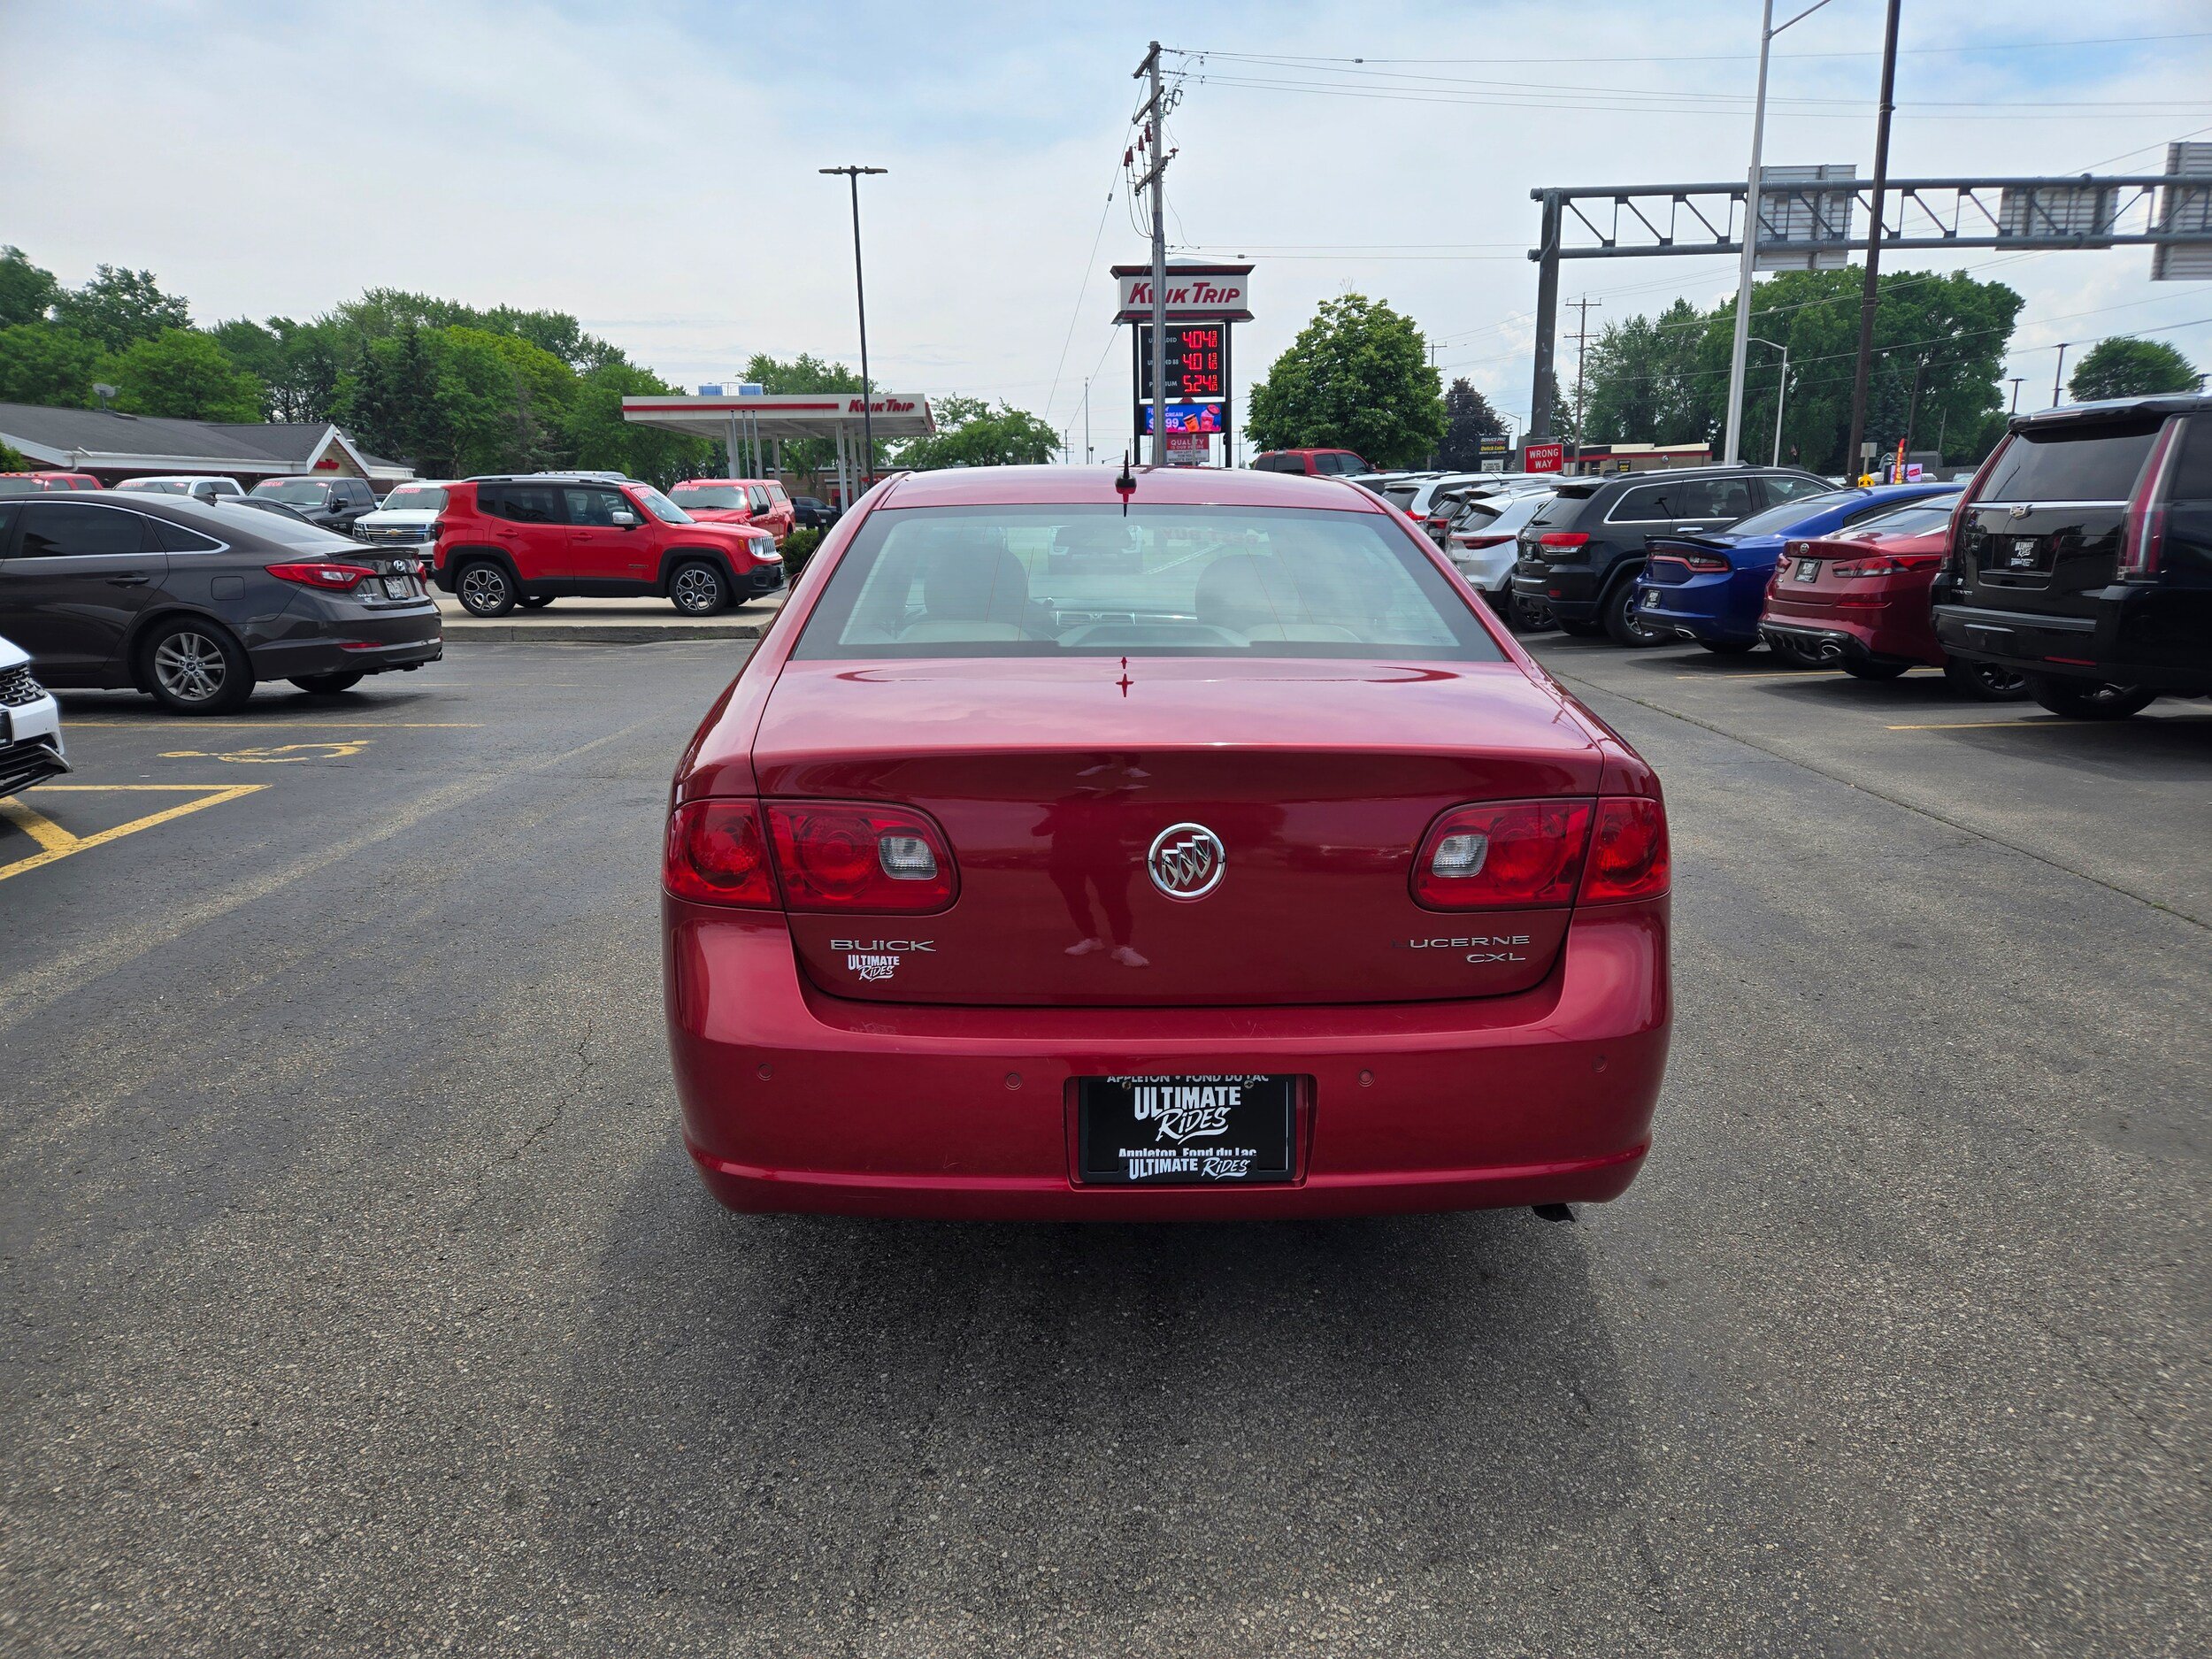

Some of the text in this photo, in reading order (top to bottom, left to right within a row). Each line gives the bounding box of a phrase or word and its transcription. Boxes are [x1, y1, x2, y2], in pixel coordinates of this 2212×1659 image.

[1192, 281, 1240, 303] TRIP
[886, 398, 915, 412] TRIP
[1530, 449, 1559, 458] WRONG
[1535, 460, 1552, 469] WAY
[830, 940, 936, 951] BUICK
[1409, 935, 1530, 949] UCERNE
[848, 955, 900, 970] ULTIMATE
[1466, 953, 1526, 963] CXL
[858, 965, 895, 982] RIDES
[1134, 1087, 1241, 1121] ULTIMATE
[1154, 1107, 1232, 1145] RIDES
[1128, 1157, 1199, 1180] ULTIMATE
[1201, 1157, 1251, 1180] RIDES
